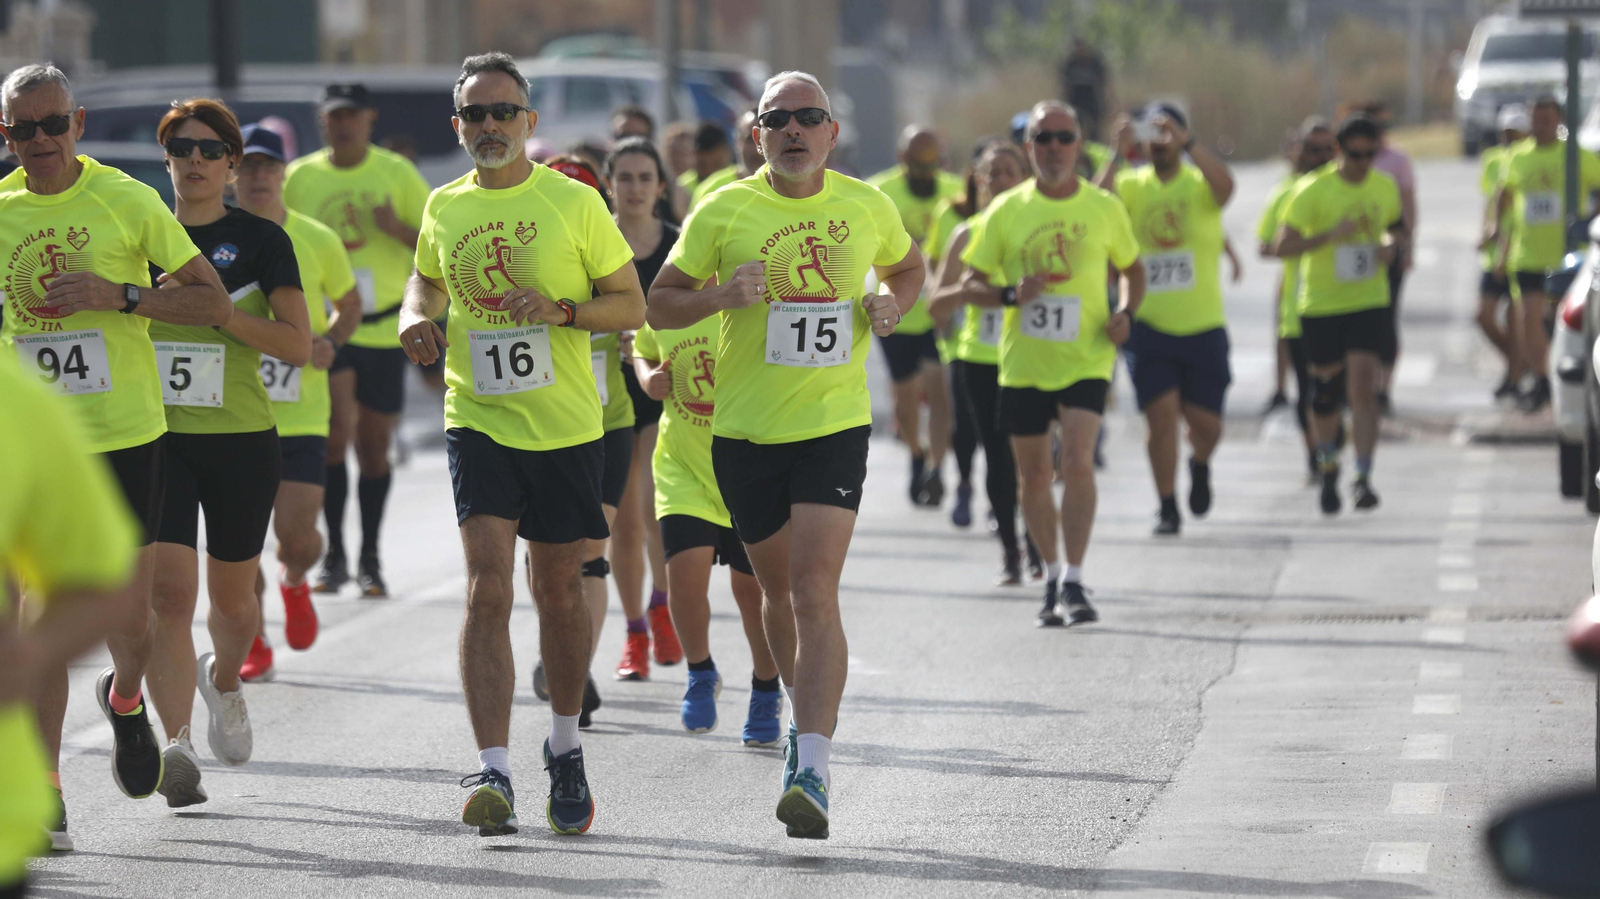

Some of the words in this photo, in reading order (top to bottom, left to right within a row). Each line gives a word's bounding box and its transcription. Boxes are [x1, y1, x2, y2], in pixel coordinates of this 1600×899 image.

[8, 228, 56, 270] POPULAR
[451, 221, 504, 259] POPULAR
[760, 221, 816, 255] POPULAR
[5, 275, 37, 328] CARRERA
[449, 263, 483, 319] CARRERA
[41, 321, 63, 331] VII
[487, 314, 508, 324] VII
[497, 331, 524, 340] SOLIDARIA
[526, 327, 544, 335] APRON
[791, 317, 837, 353] 15
[1032, 304, 1064, 331] 31
[50, 334, 78, 343] SOLIDARIA
[669, 336, 708, 361] OPULAR
[37, 344, 89, 384] 94
[169, 356, 192, 391] 5
[486, 341, 534, 380] 16
